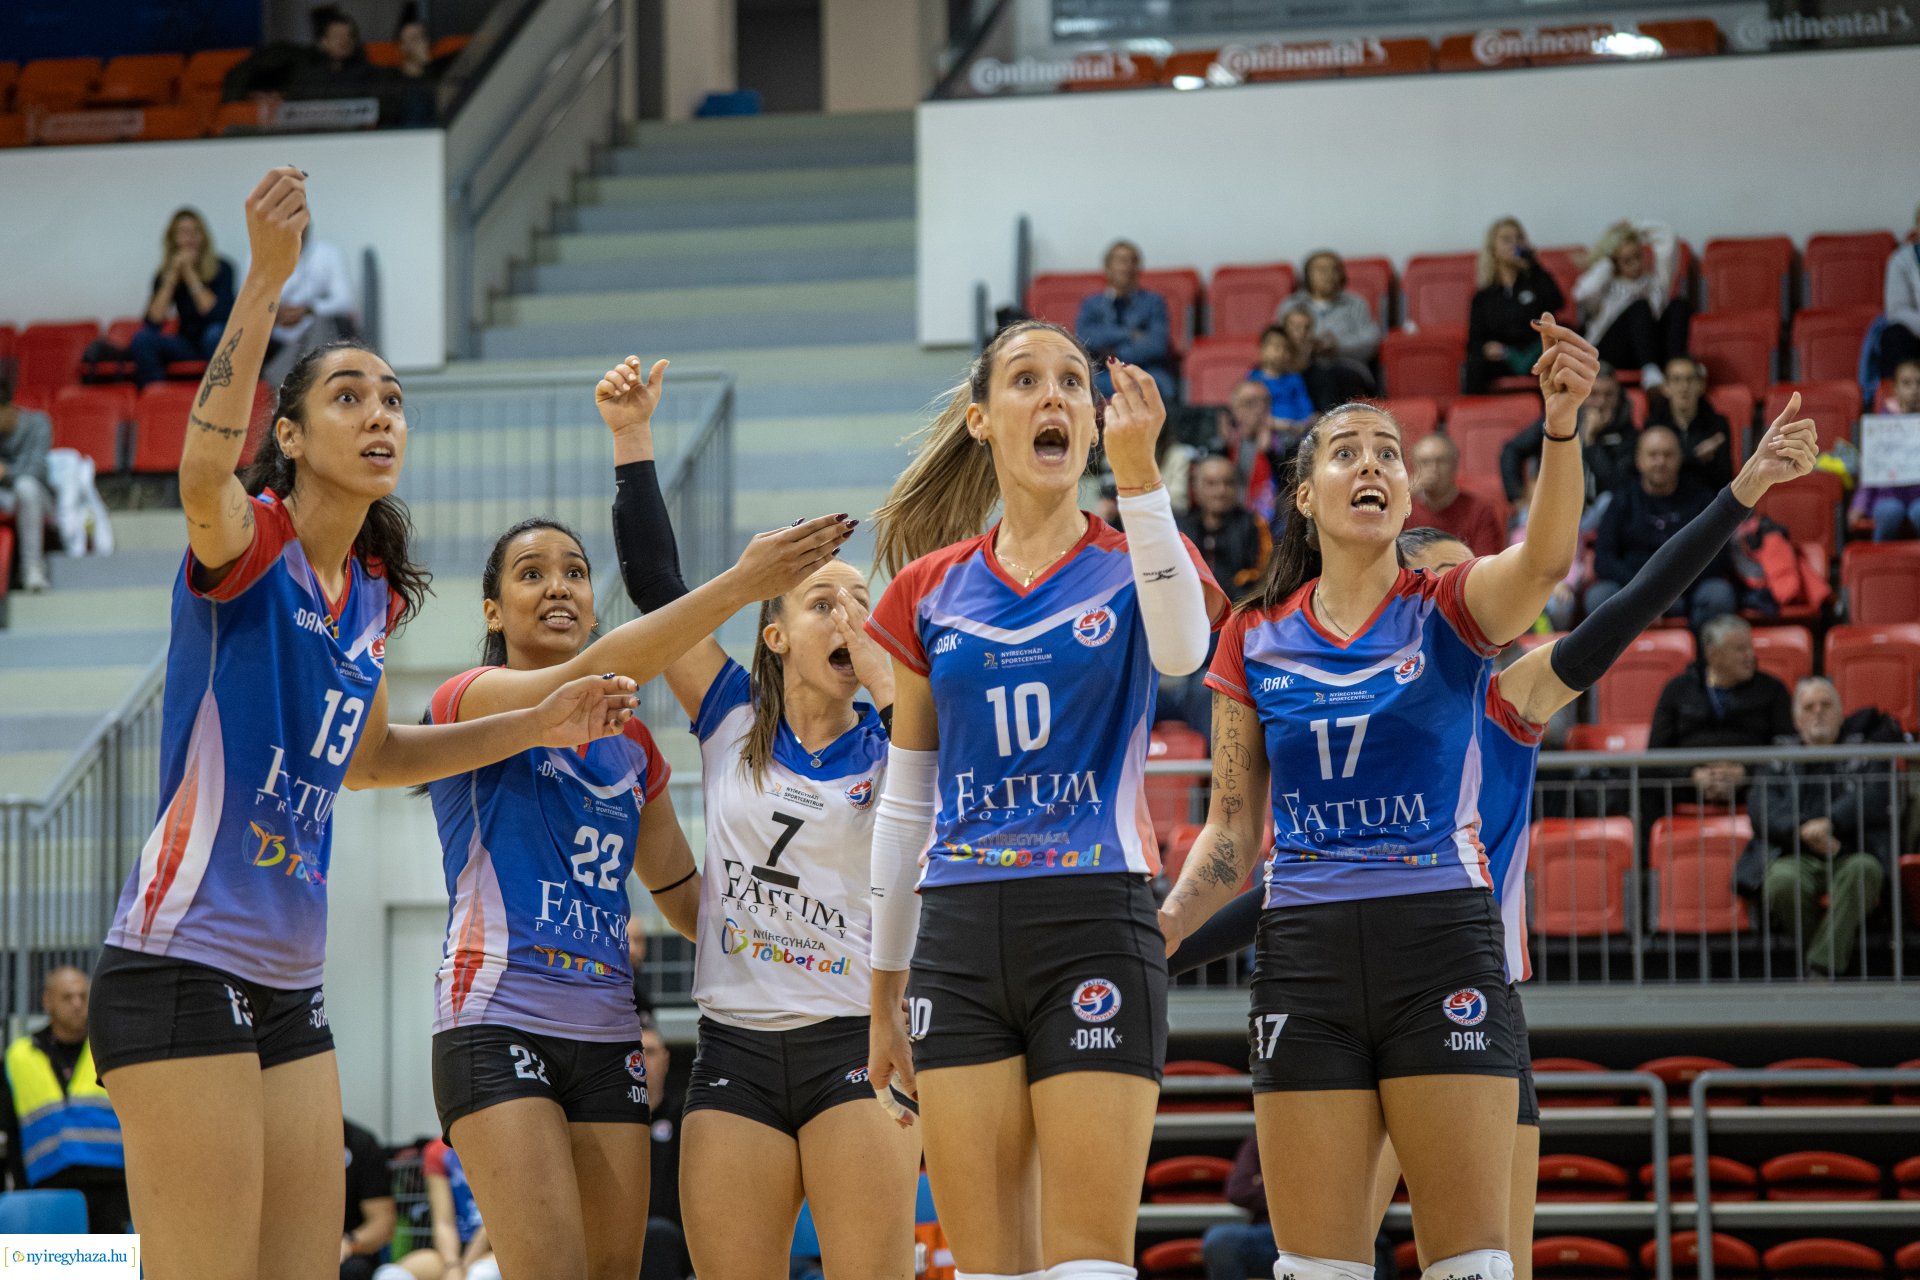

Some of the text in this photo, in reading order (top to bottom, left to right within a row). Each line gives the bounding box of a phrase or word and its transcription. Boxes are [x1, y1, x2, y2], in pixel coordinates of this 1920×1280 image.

[969, 52, 1115, 94] Continental
[1217, 37, 1366, 80] Continental
[1001, 653, 1052, 665] SPORTCENTRUM
[310, 688, 365, 766] 13
[986, 682, 1050, 757] 10
[1310, 714, 1370, 780] 17
[943, 804, 1102, 827] ROPERTY
[955, 767, 1102, 820] FATUM
[1282, 788, 1430, 834] FATUM
[571, 825, 623, 891] 22
[766, 811, 805, 867] 7
[721, 897, 847, 938] PROPEY
[753, 929, 826, 951] NYÍREGYHÁZA
[751, 942, 851, 975] Többet ad!
[909, 996, 933, 1042] 10
[1255, 1014, 1289, 1059] 17
